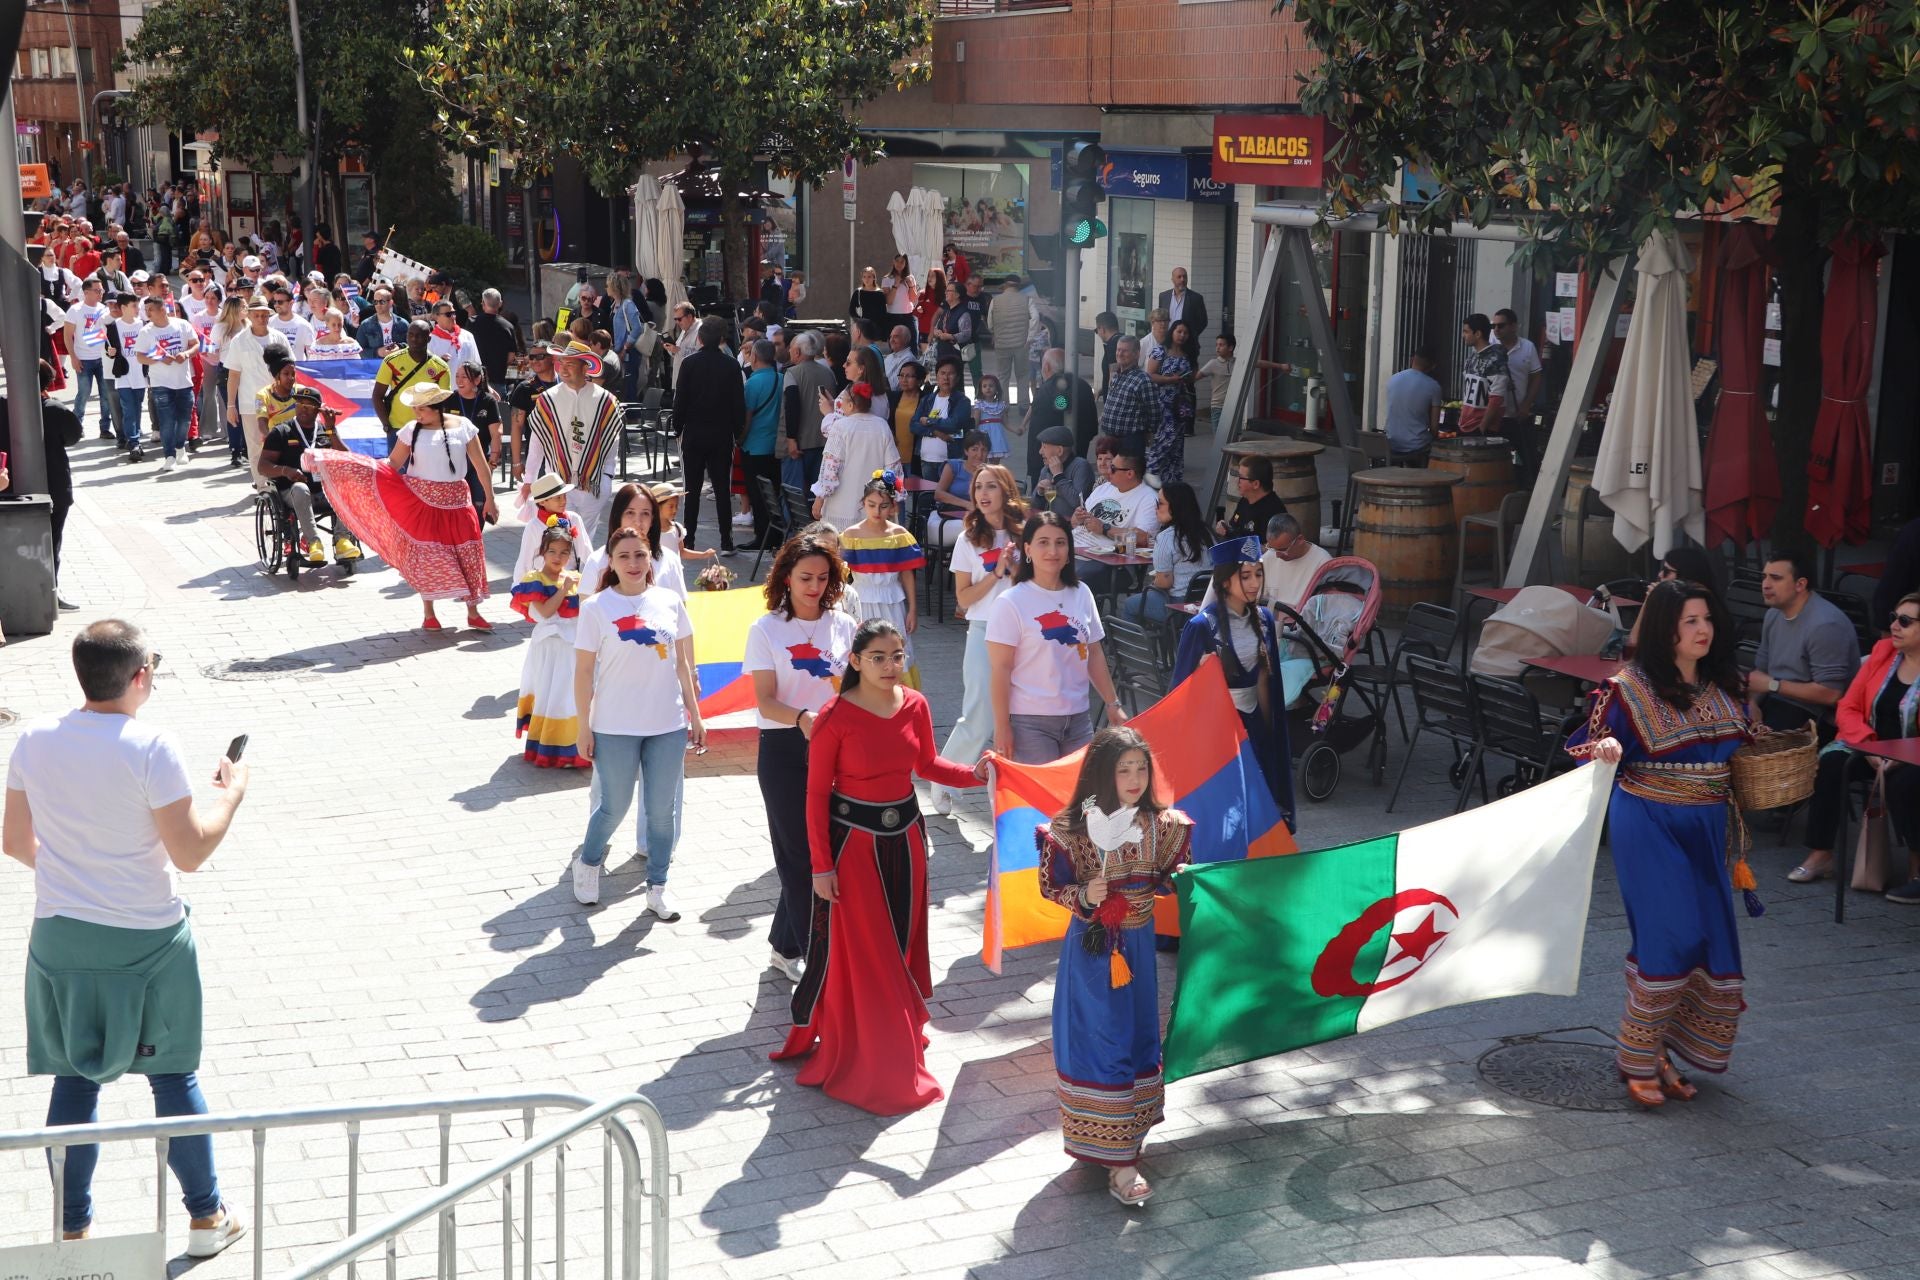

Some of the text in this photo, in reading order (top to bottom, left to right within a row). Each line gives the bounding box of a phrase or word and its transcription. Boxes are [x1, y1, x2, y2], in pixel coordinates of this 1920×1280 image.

[1238, 135, 1308, 157] TABACOS
[1132, 169, 1161, 188] Seguros
[1193, 177, 1227, 190] MGS
[45, 1271, 115, 1280] NEDO
